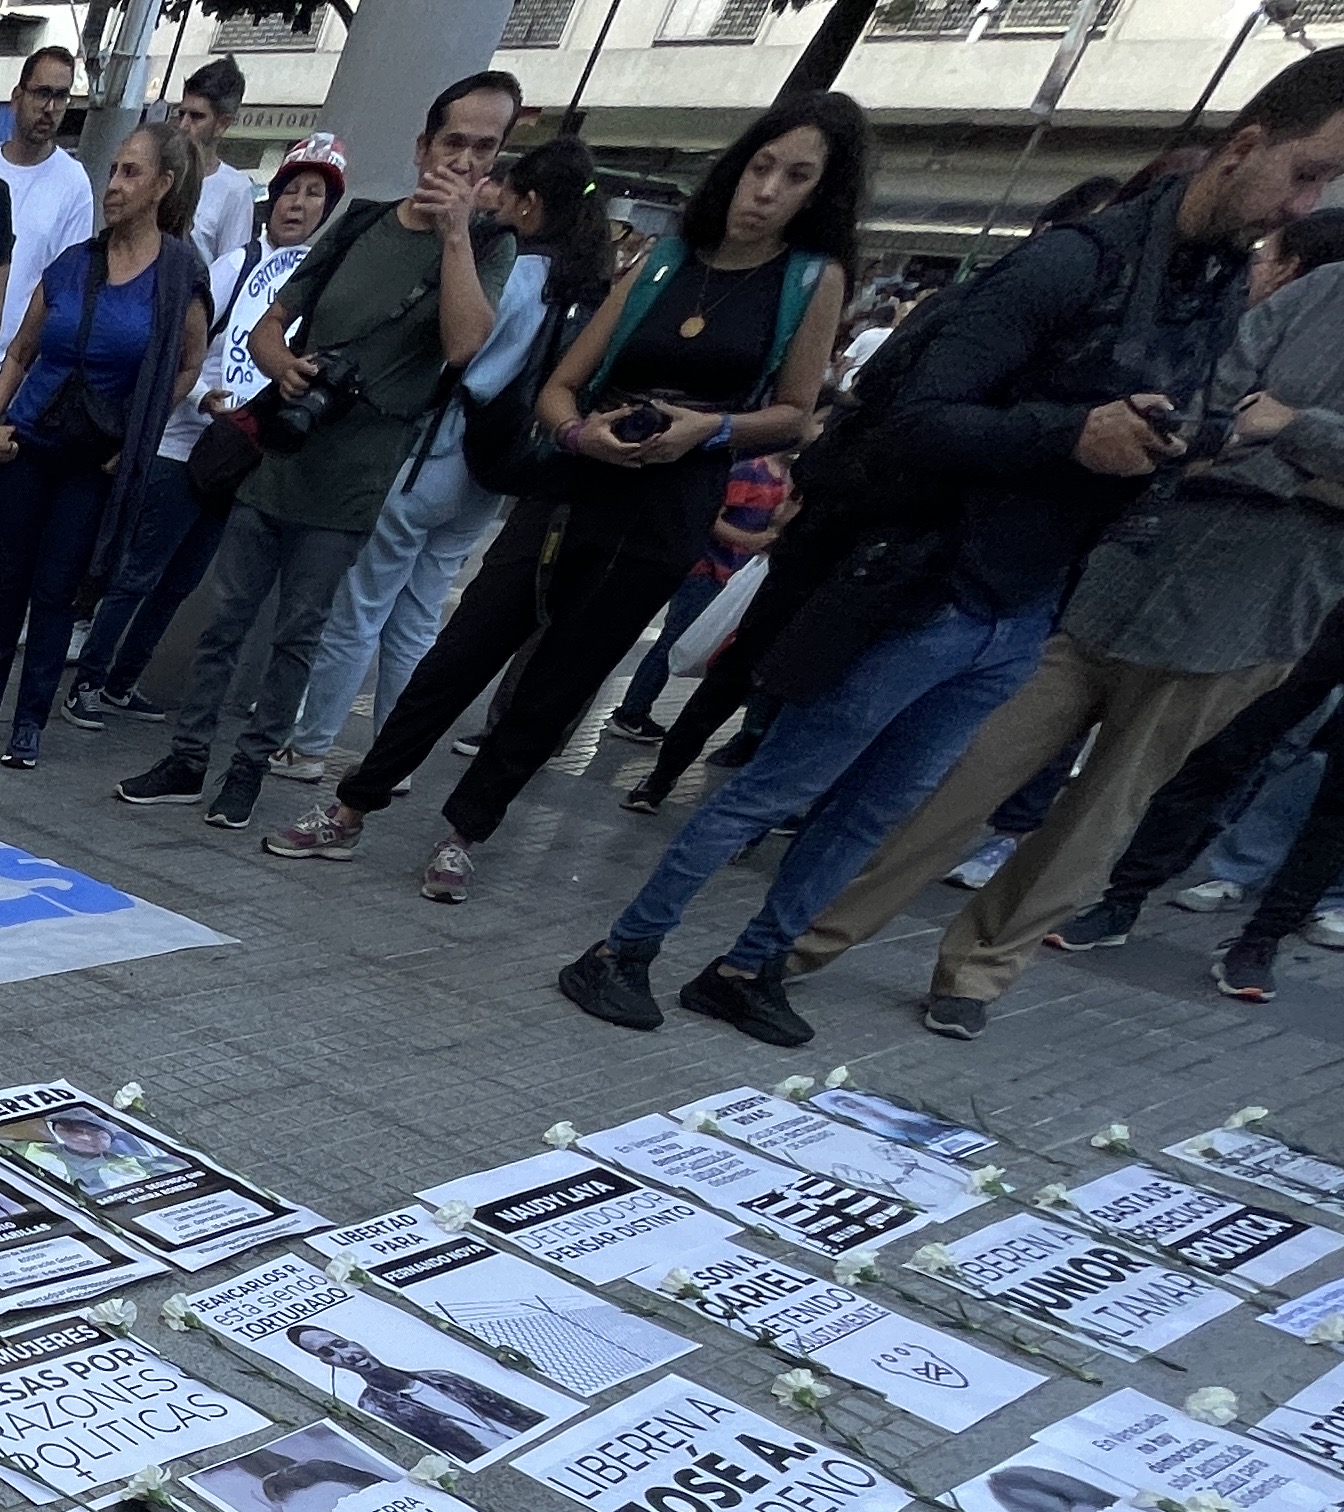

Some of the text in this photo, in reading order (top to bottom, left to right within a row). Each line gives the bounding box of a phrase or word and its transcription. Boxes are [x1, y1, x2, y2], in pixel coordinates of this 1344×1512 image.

[494, 1179, 615, 1224] NAUDY LAYA
[514, 1190, 666, 1251] DETENIDO POR
[328, 1213, 418, 1247] LIBERTAD
[369, 1232, 430, 1255] PARA
[544, 1204, 697, 1264] PENSAR DISTINTO
[190, 1262, 305, 1313] JEANCARLOS R.
[382, 1253, 450, 1282] FERNANDO
[212, 1271, 330, 1327] está siendo
[232, 1287, 349, 1341] TORTURADO
[64, 1347, 146, 1382] POR
[9, 1393, 229, 1473] POLÍTICAS
[546, 1396, 736, 1500] LIBEREN A
[734, 1432, 819, 1474] A.
